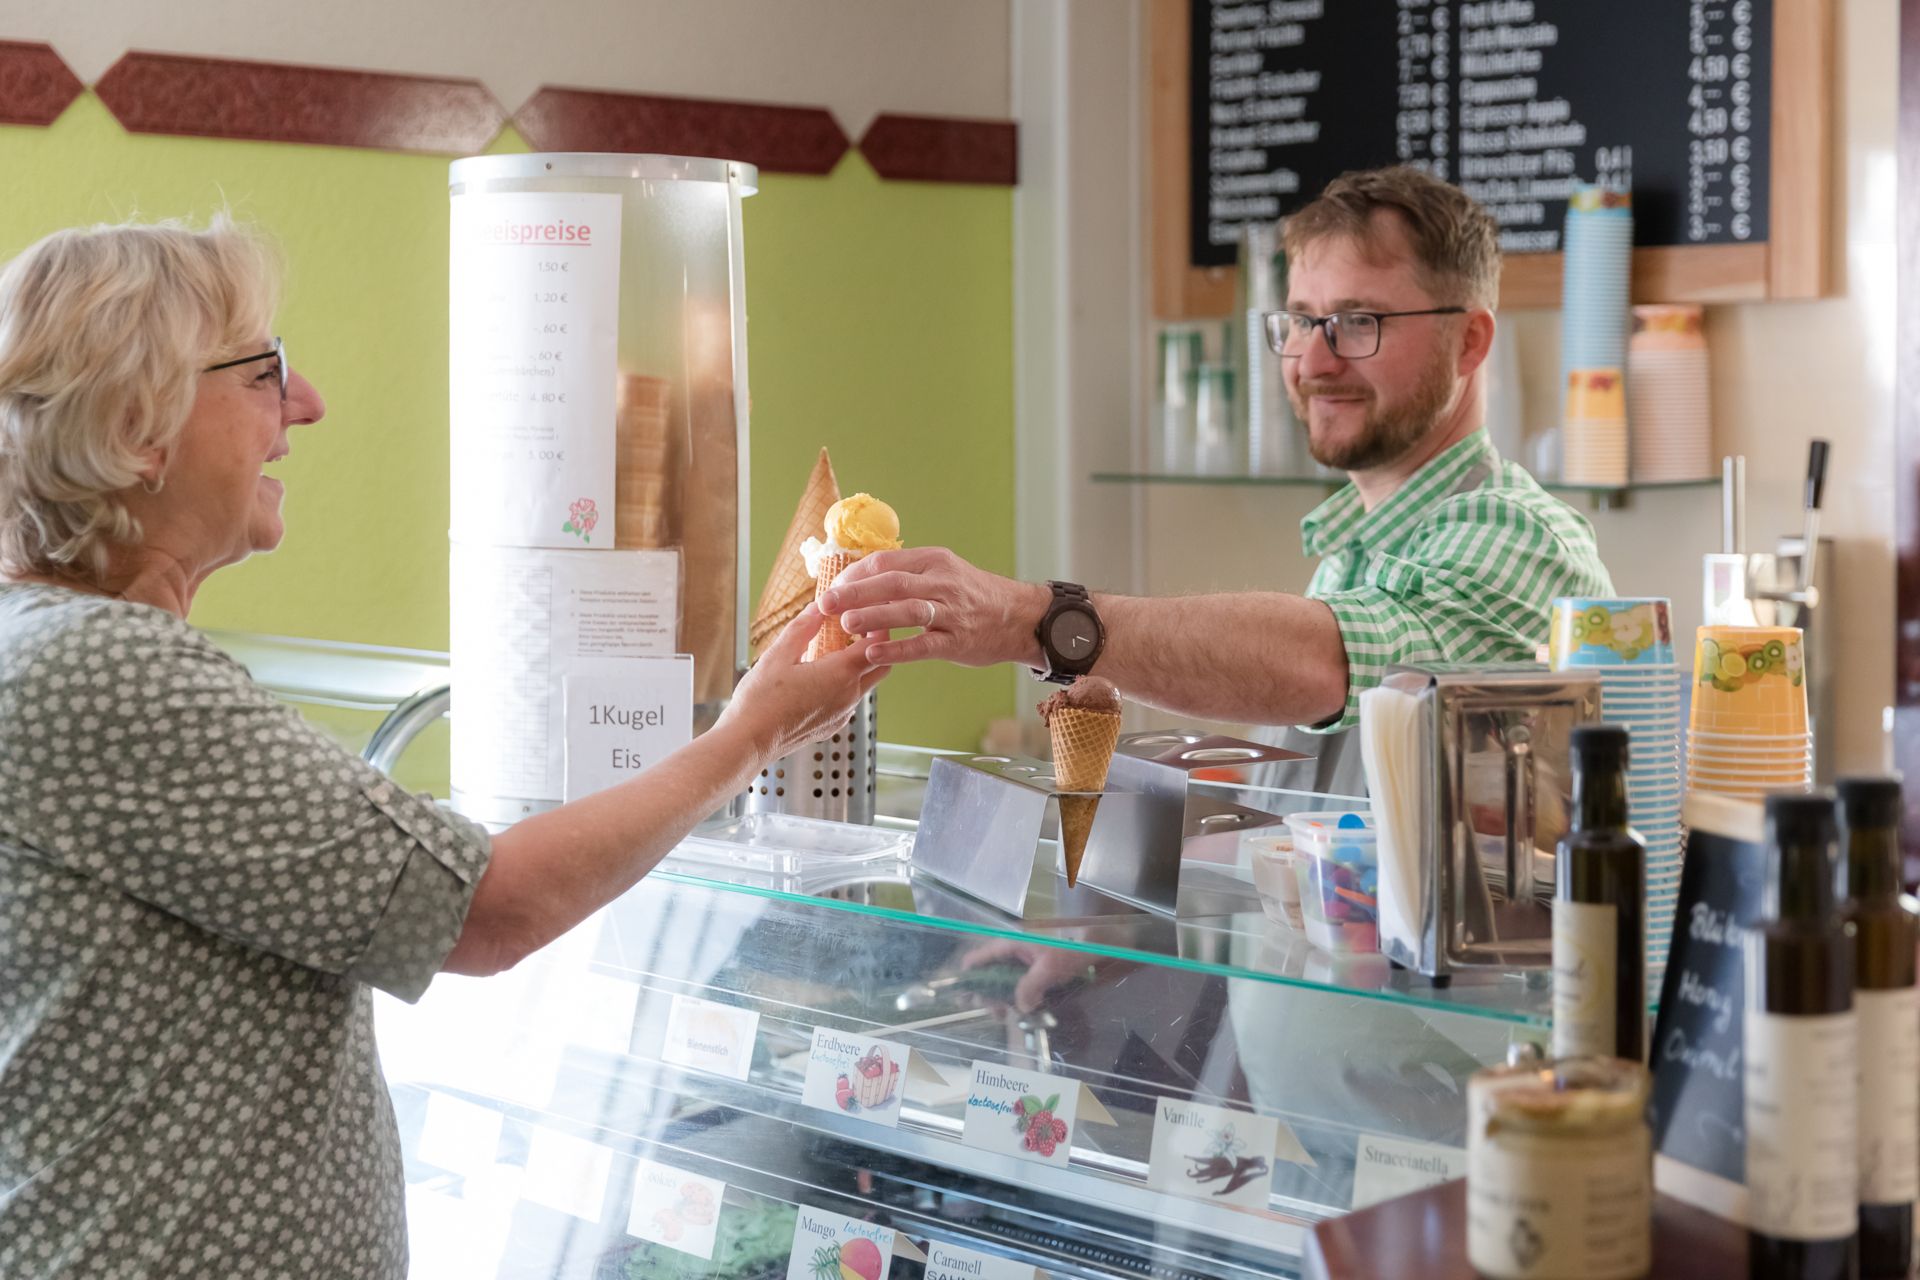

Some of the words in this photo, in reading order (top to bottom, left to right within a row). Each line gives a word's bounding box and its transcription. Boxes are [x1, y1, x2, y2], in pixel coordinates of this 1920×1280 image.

[538, 261, 558, 273] 1,50
[589, 705, 664, 731] 1Kugel
[612, 748, 642, 769] Eis
[687, 1038, 729, 1056] Bienenstich
[816, 1034, 861, 1057] Erdbeere
[976, 1069, 1030, 1093] Himbeere
[1163, 1106, 1205, 1130] Vanille
[1365, 1144, 1449, 1176] Stracciatella
[641, 1167, 678, 1189] Cookies
[801, 1216, 836, 1240] Mango
[933, 1250, 982, 1275] Caramell
